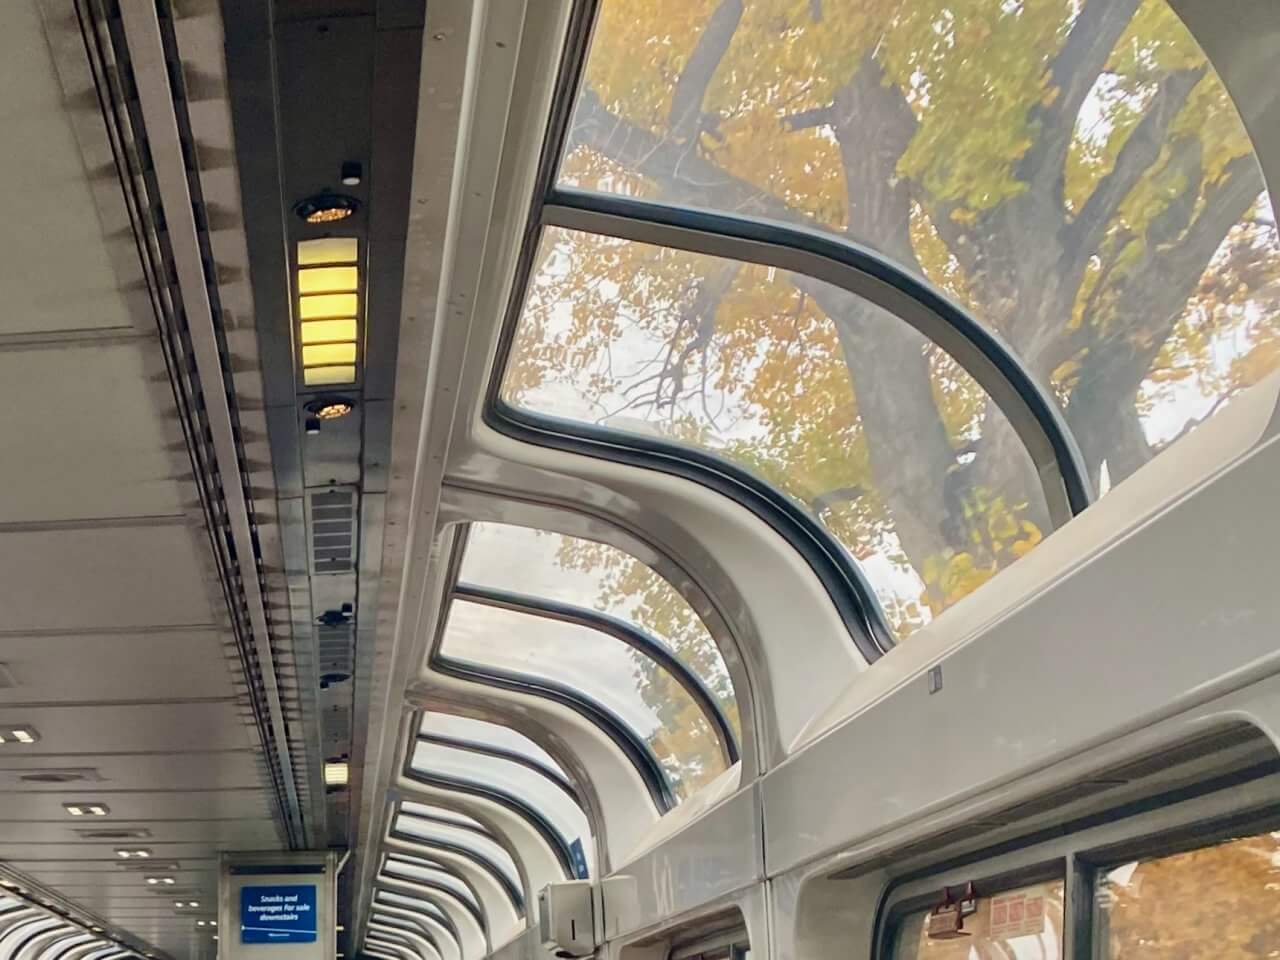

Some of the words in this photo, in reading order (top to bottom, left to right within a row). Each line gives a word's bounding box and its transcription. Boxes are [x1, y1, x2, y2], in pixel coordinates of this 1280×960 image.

[284, 894, 298, 902] and
[248, 905, 282, 913] beverages
[284, 904, 295, 912] for
[260, 913, 298, 921] downstairs
